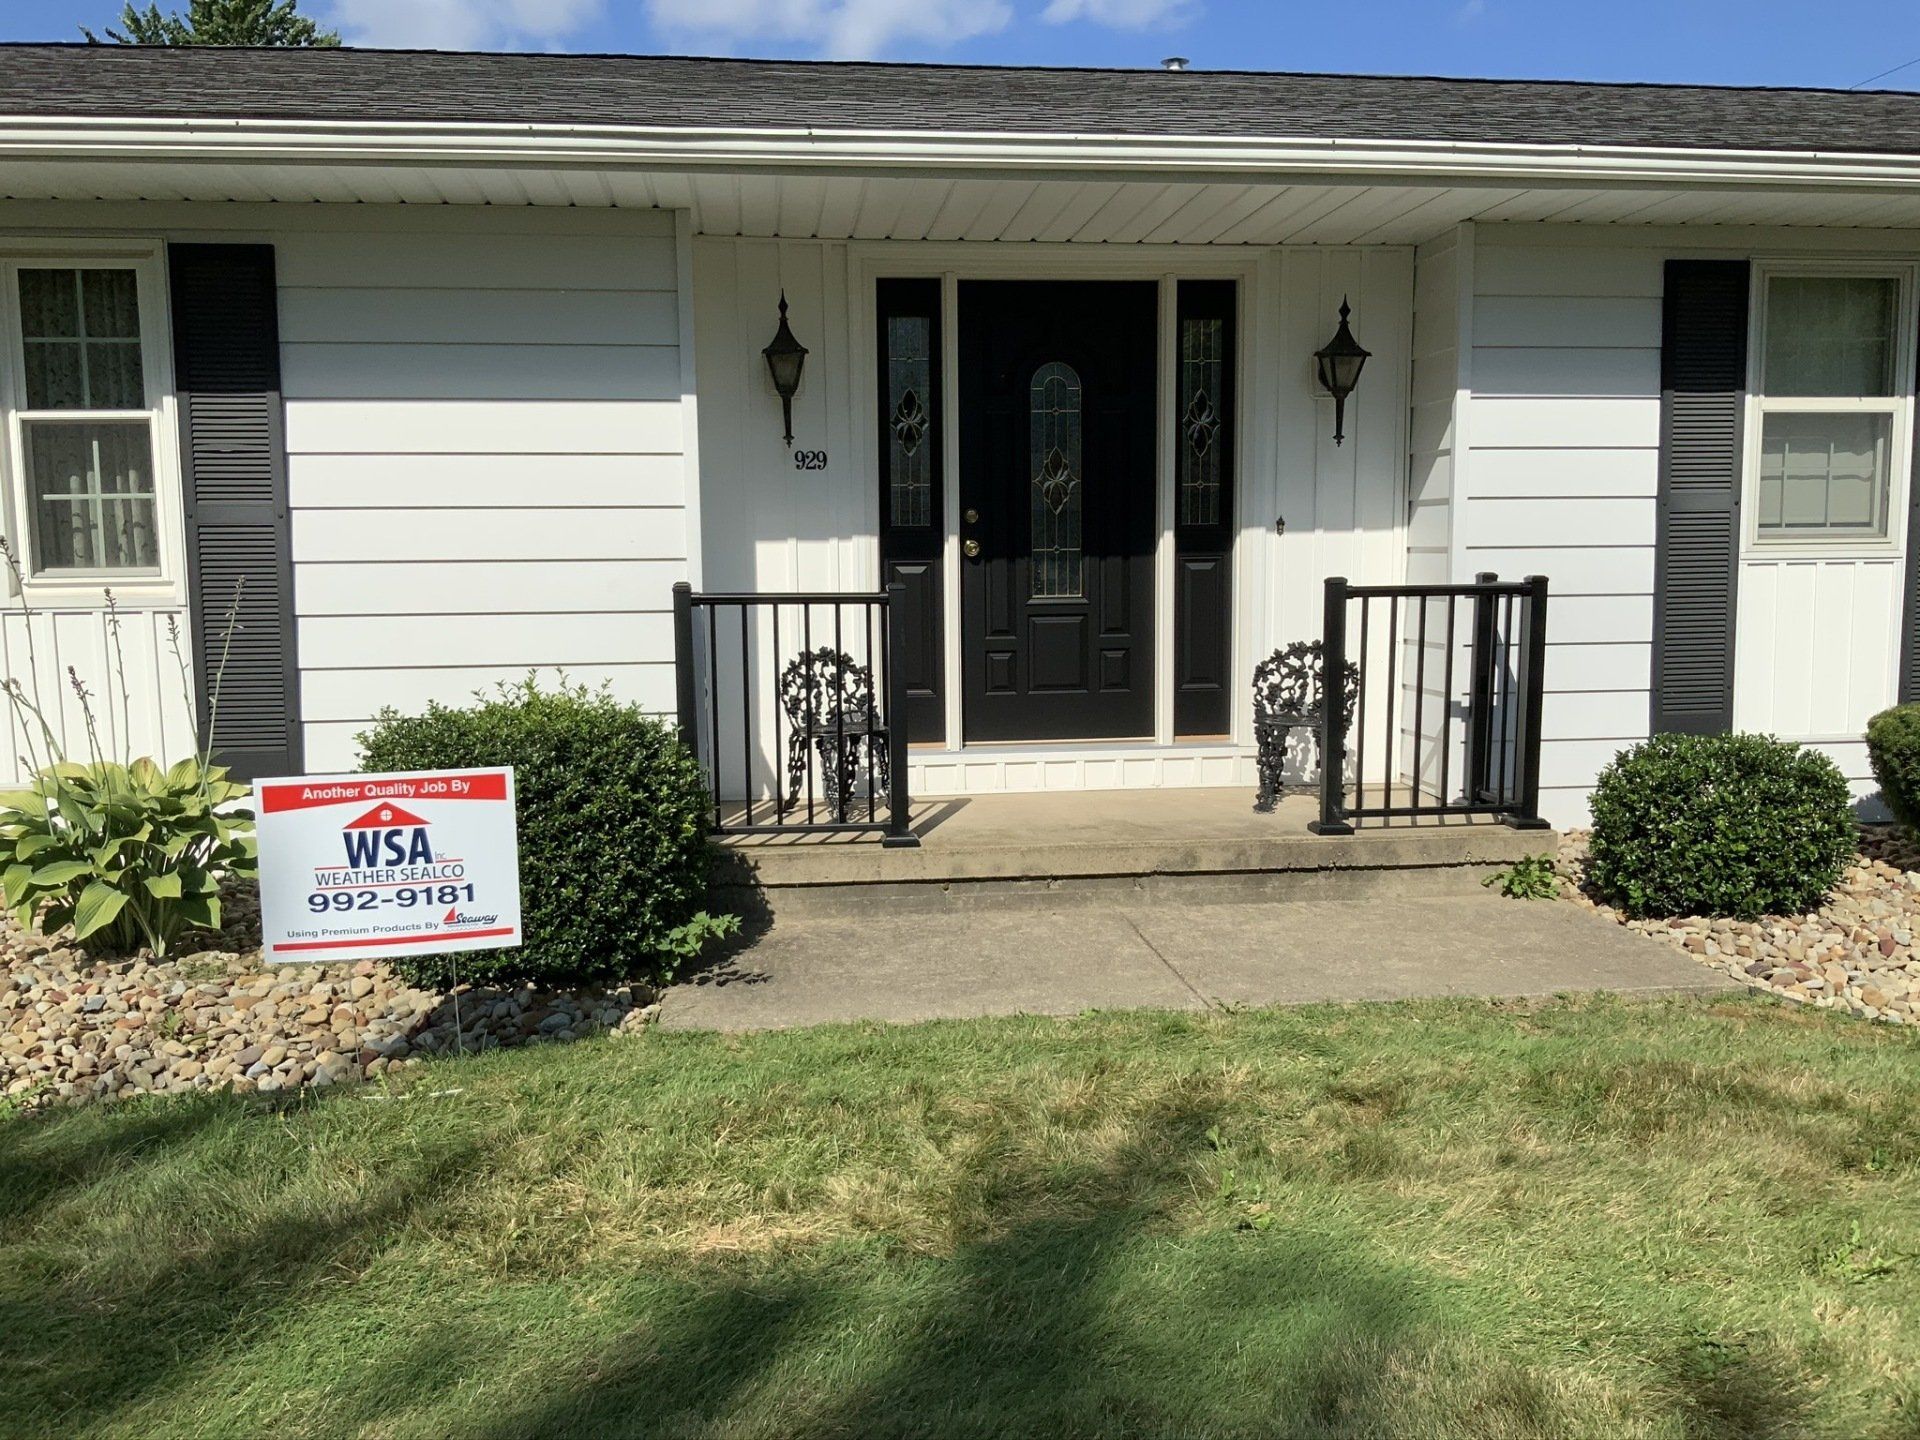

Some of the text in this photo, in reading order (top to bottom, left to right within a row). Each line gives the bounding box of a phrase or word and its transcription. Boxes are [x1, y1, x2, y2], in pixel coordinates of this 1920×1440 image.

[795, 450, 828, 470] 929
[302, 778, 471, 801] Another Quality Job By
[342, 827, 434, 869] WSA
[315, 868, 396, 887] WEATHER
[307, 882, 476, 913] 992-9181
[455, 913, 498, 925] Seaway
[287, 929, 319, 939] Using
[321, 927, 370, 937] Premium
[372, 924, 422, 934] Products
[425, 921, 440, 932] By
